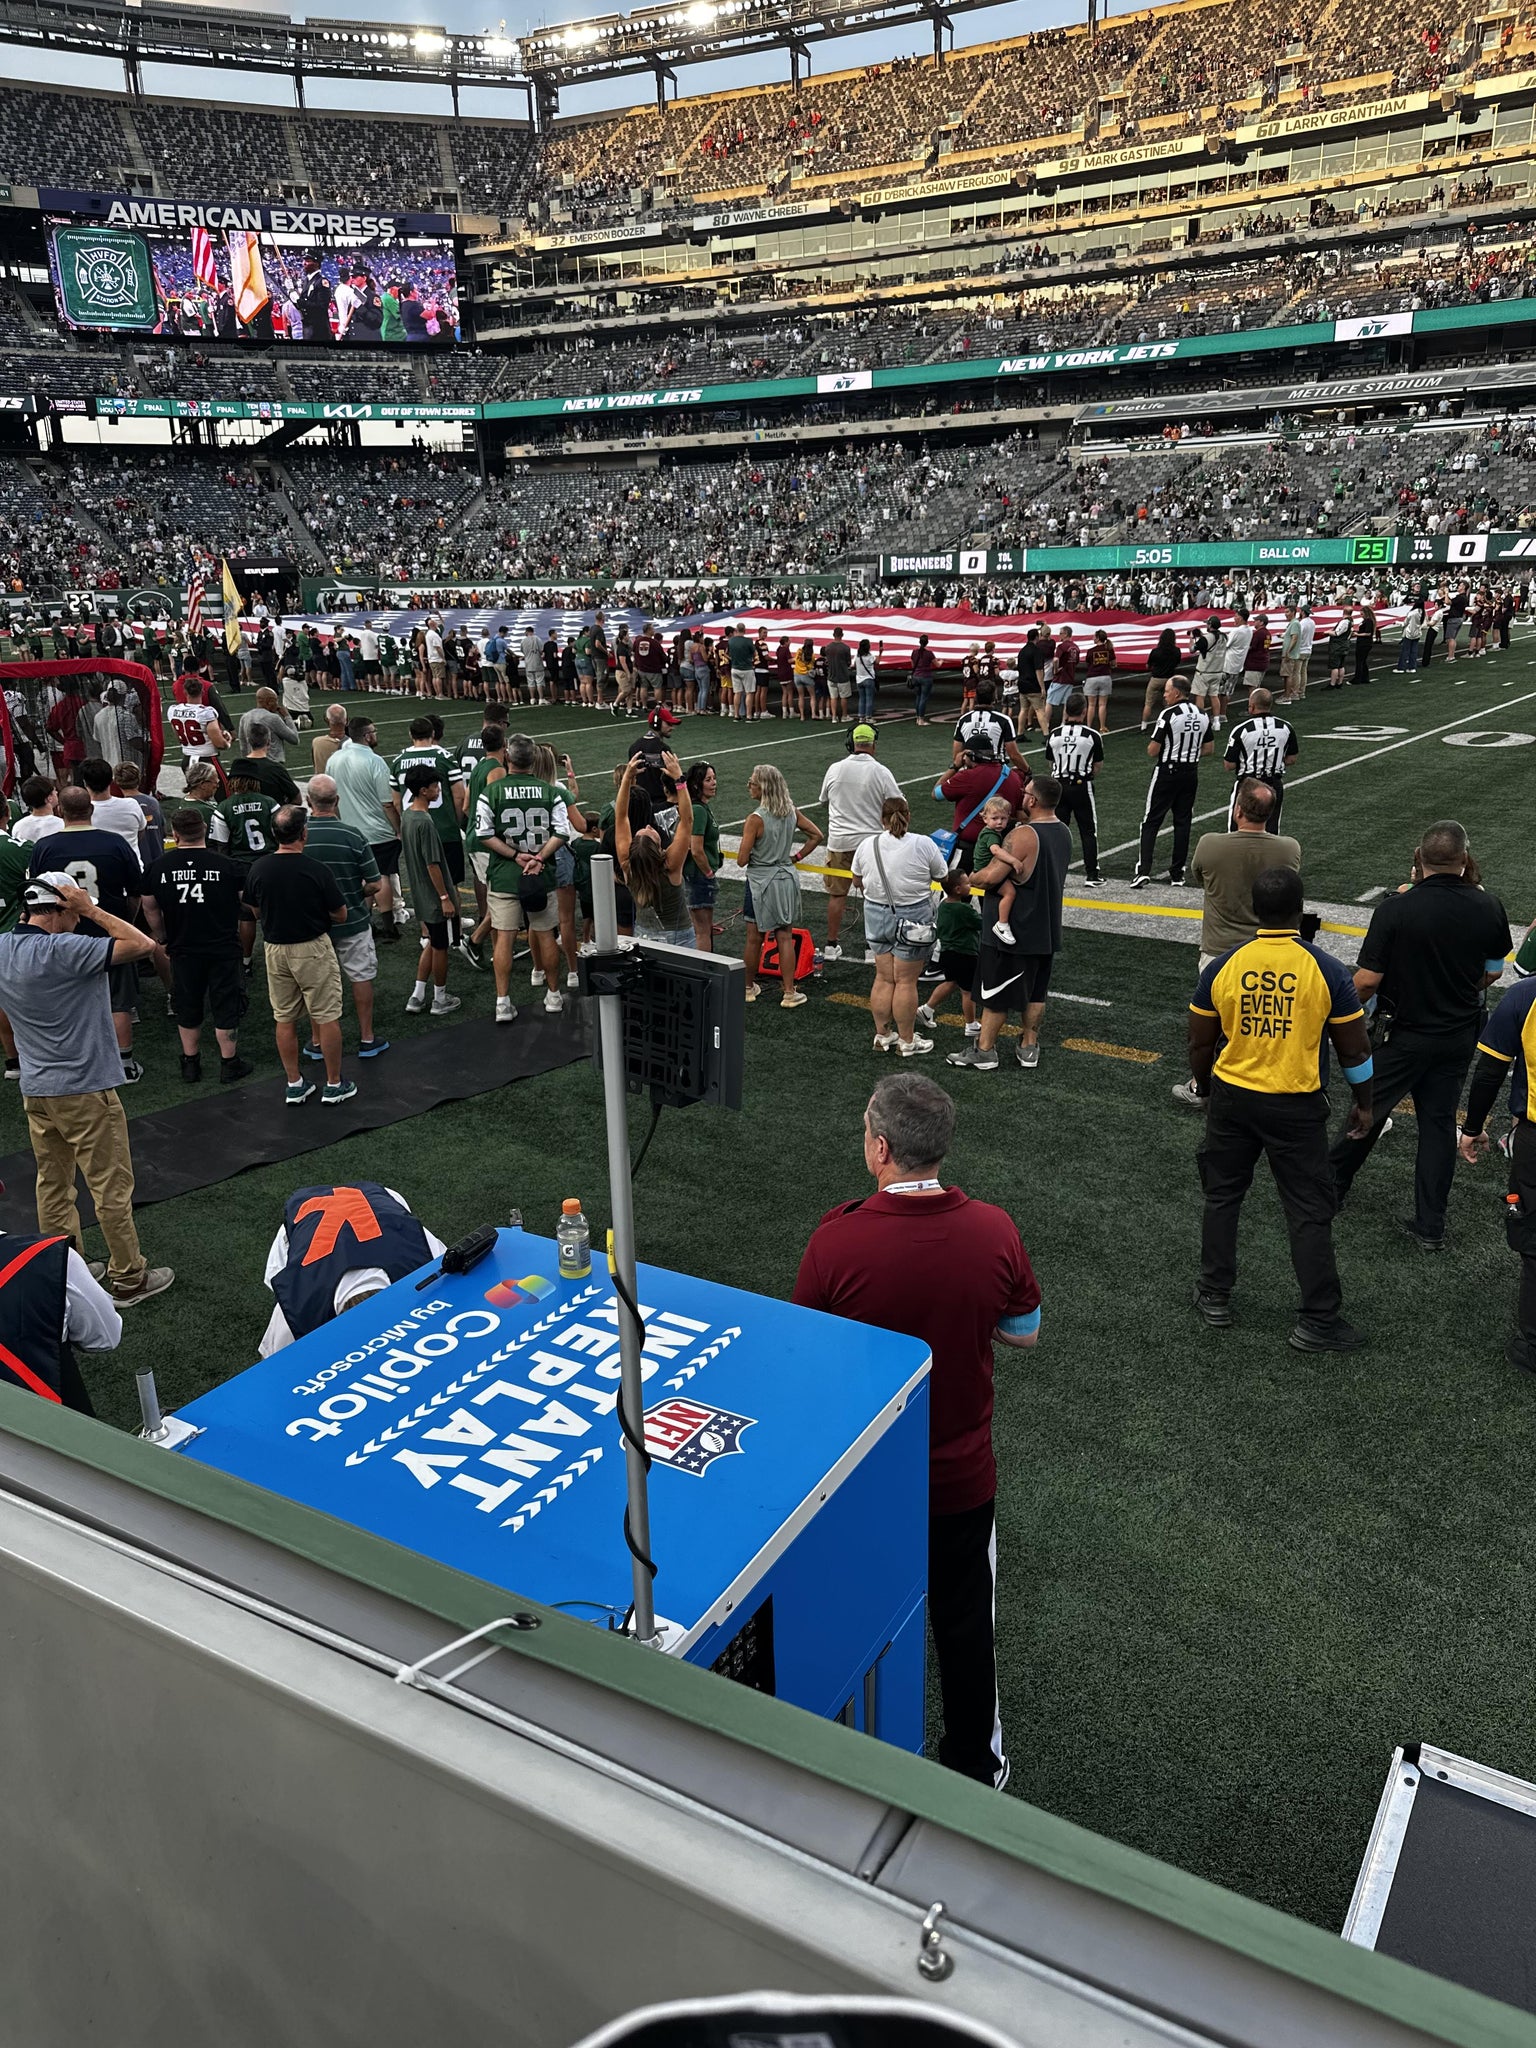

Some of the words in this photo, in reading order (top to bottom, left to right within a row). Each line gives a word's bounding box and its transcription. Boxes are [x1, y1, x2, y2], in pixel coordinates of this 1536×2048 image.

[1256, 123, 1280, 139] 60
[1285, 114, 1328, 132] LARRY
[1330, 99, 1406, 124] GRANTHAM
[1058, 159, 1079, 173] 99
[1084, 153, 1118, 168] MARK
[1120, 141, 1183, 162] GASTINEAU
[863, 191, 881, 205] 60
[884, 179, 956, 200] D'BRICKASHAW
[957, 171, 1008, 190] FERGUSON
[108, 201, 263, 231] AMERICAN
[269, 211, 396, 238] EXPRESS
[712, 214, 730, 226] 80
[733, 210, 766, 223] WAYNE
[767, 203, 809, 218] CHREBET
[550, 236, 565, 247] 32
[569, 230, 610, 244] EMERSON
[611, 226, 646, 239] BOOZER
[90, 251, 117, 261] HVFD
[998, 355, 1053, 373] NEW
[1053, 349, 1118, 368] YORK
[1118, 341, 1180, 361] JETS
[1288, 384, 1359, 400] METLIFE
[1362, 376, 1443, 393] STADIUM
[143, 404, 164, 412] FINAL
[272, 403, 281, 411] 19
[562, 398, 606, 411] NEW
[607, 393, 657, 408] YORK
[657, 389, 703, 404] JETS
[1115, 402, 1165, 413] MetLife
[202, 409, 212, 417] 14
[381, 407, 400, 416] OUT
[400, 407, 414, 416] OF
[414, 407, 441, 416] TOWN
[442, 407, 476, 416] SCORES
[764, 431, 786, 440] MetLife
[1297, 431, 1326, 440] NEW
[1365, 426, 1398, 435] JETS
[1135, 549, 1173, 564] 5:05
[1258, 547, 1290, 559] BALL
[1292, 546, 1311, 558] ON
[1357, 543, 1384, 559] 25
[1413, 539, 1432, 551] TOL
[1459, 541, 1476, 556] 0
[890, 554, 953, 573] BUCCANEERS
[967, 556, 980, 570] 0
[998, 552, 1012, 562] TOL
[974, 721, 986, 729] BJ
[1184, 721, 1200, 732] 56
[1062, 743, 1077, 754] 17
[1064, 736, 1077, 744] DJ
[1256, 737, 1277, 748] 42
[400, 757, 436, 770] FITZPATRICK
[504, 787, 542, 799] MARTIN
[232, 802, 262, 815] SANCHEZ
[245, 819, 266, 851] 6
[500, 807, 550, 853] 28
[161, 872, 167, 883] A
[172, 870, 196, 881] TRUE
[202, 870, 220, 881] JET
[176, 883, 204, 903] 74
[1241, 970, 1297, 993] CSC
[1241, 994, 1294, 1017] EVENT
[1240, 1016, 1292, 1039] STAFF
[562, 1244, 574, 1257] G
[410, 1300, 453, 1320] by
[292, 1319, 421, 1396] Microsoft
[285, 1310, 500, 1442] Copilot
[391, 1296, 658, 1490] REPLAY
[447, 1311, 712, 1514] INSTANT
